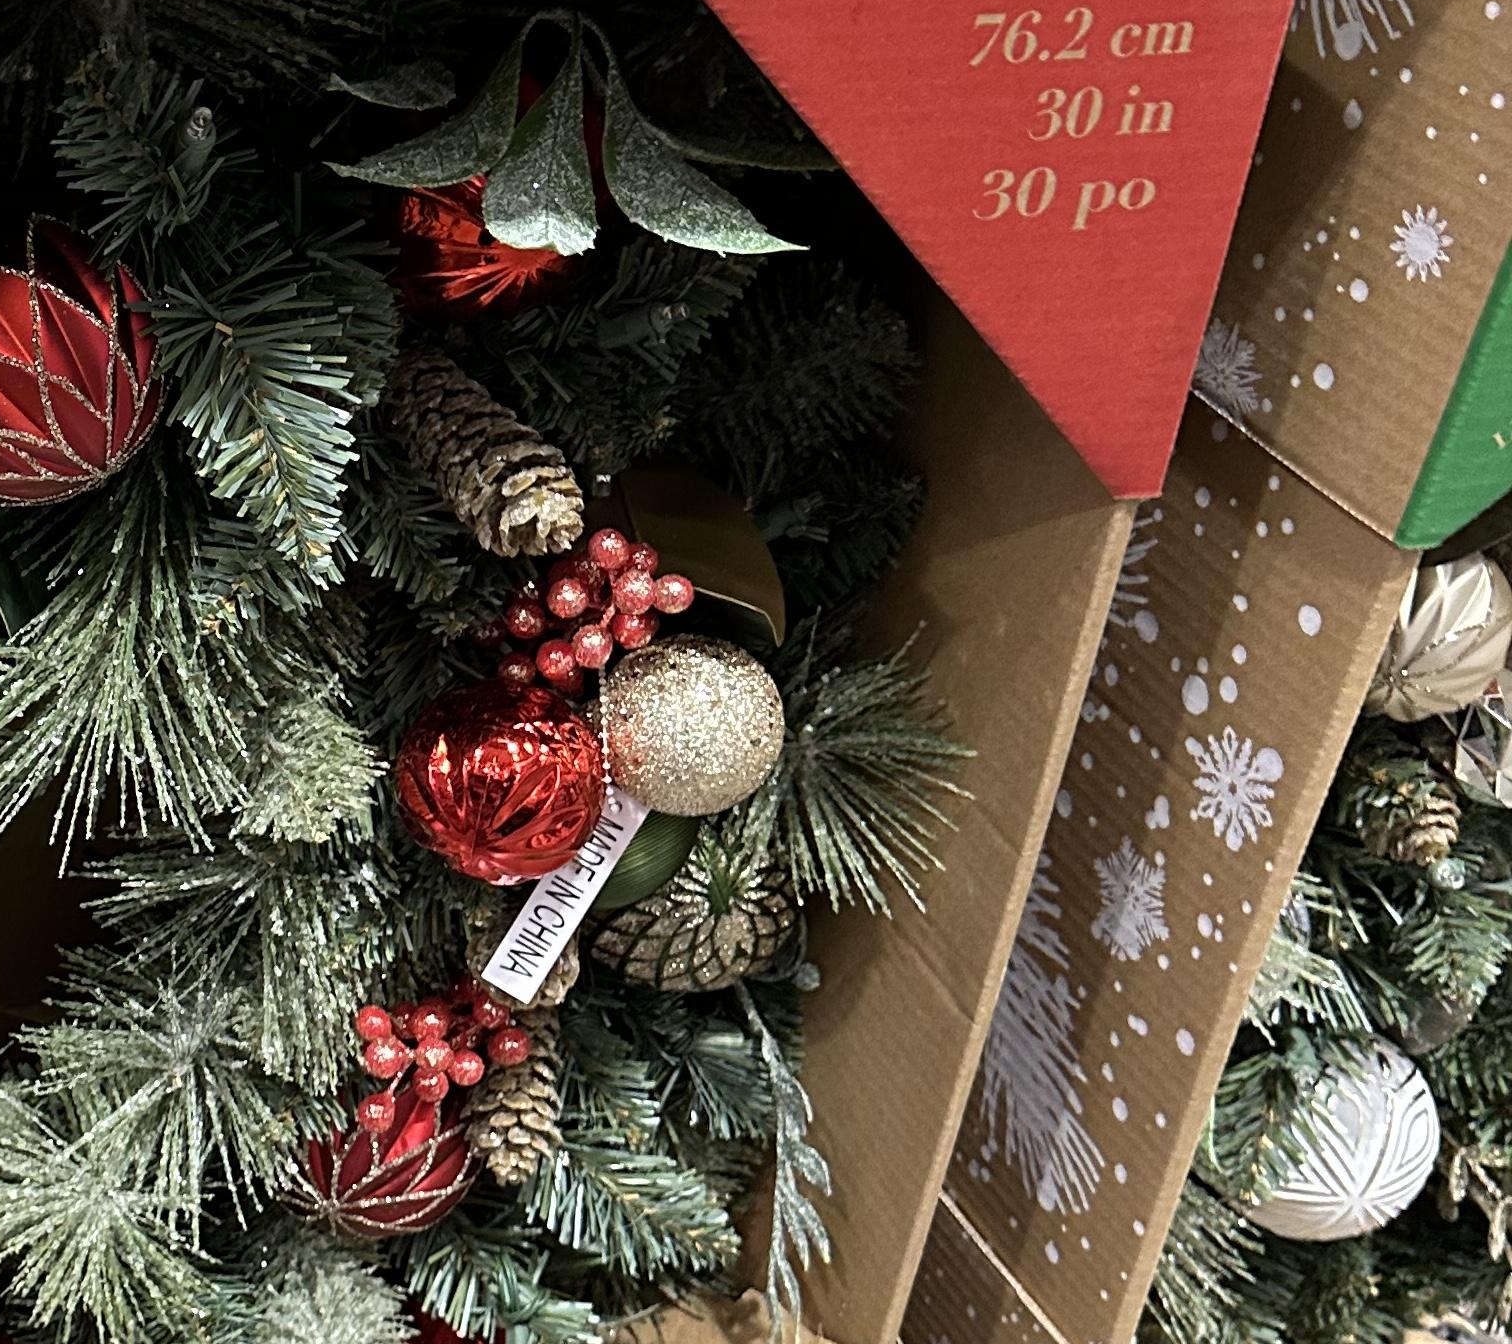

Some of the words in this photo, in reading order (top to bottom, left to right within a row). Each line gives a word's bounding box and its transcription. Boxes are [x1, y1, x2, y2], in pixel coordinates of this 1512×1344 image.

[969, 7, 1094, 67] 76.2
[1110, 19, 1194, 57] cm
[1026, 86, 1103, 141] 30
[1115, 85, 1175, 135] in
[972, 167, 1057, 220] 30
[1072, 177, 1156, 230] po
[571, 814, 624, 883] MADE
[545, 874, 585, 909] IN
[499, 904, 565, 978] CHINA
